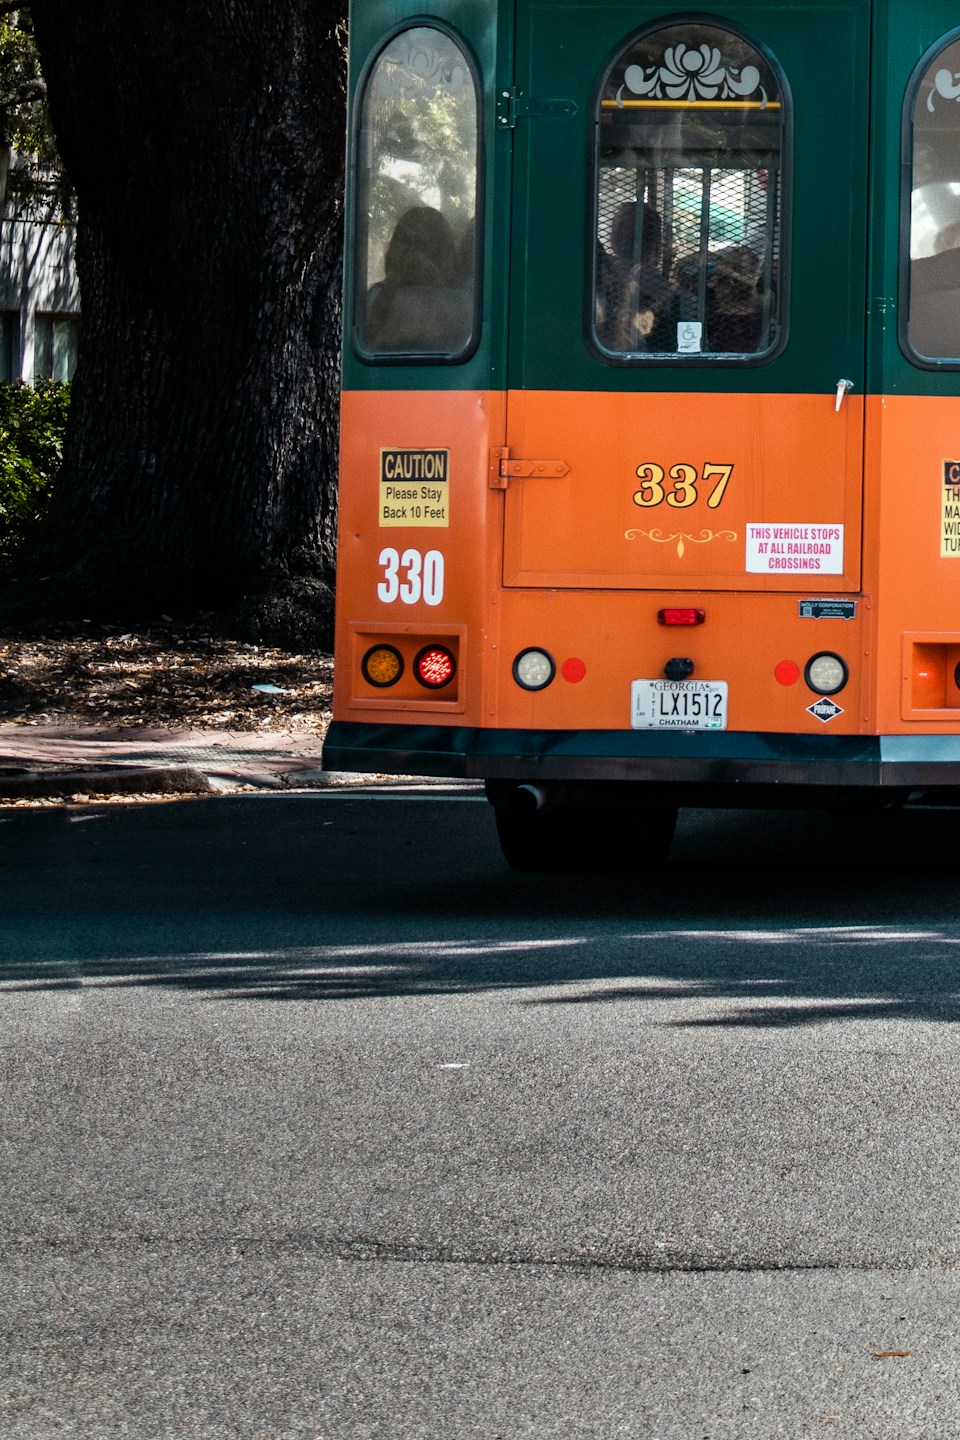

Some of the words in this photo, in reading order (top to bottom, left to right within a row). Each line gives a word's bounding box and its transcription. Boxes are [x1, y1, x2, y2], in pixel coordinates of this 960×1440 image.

[385, 453, 445, 479] CAUTION
[632, 462, 734, 509] 337
[386, 486, 418, 500] Please
[421, 486, 442, 503] Stay
[383, 506, 407, 519] Back
[411, 506, 421, 519] 10
[424, 506, 445, 519] Feet
[750, 527, 771, 539] THIS
[773, 527, 809, 540] VEHICLE
[811, 528, 840, 540] STOPS
[758, 542, 768, 554] AT
[770, 542, 785, 554] ALL
[787, 543, 831, 555] RAILROAD
[768, 557, 821, 570] CROSSINGS
[377, 547, 445, 606] 330
[660, 692, 723, 717] LX1512
